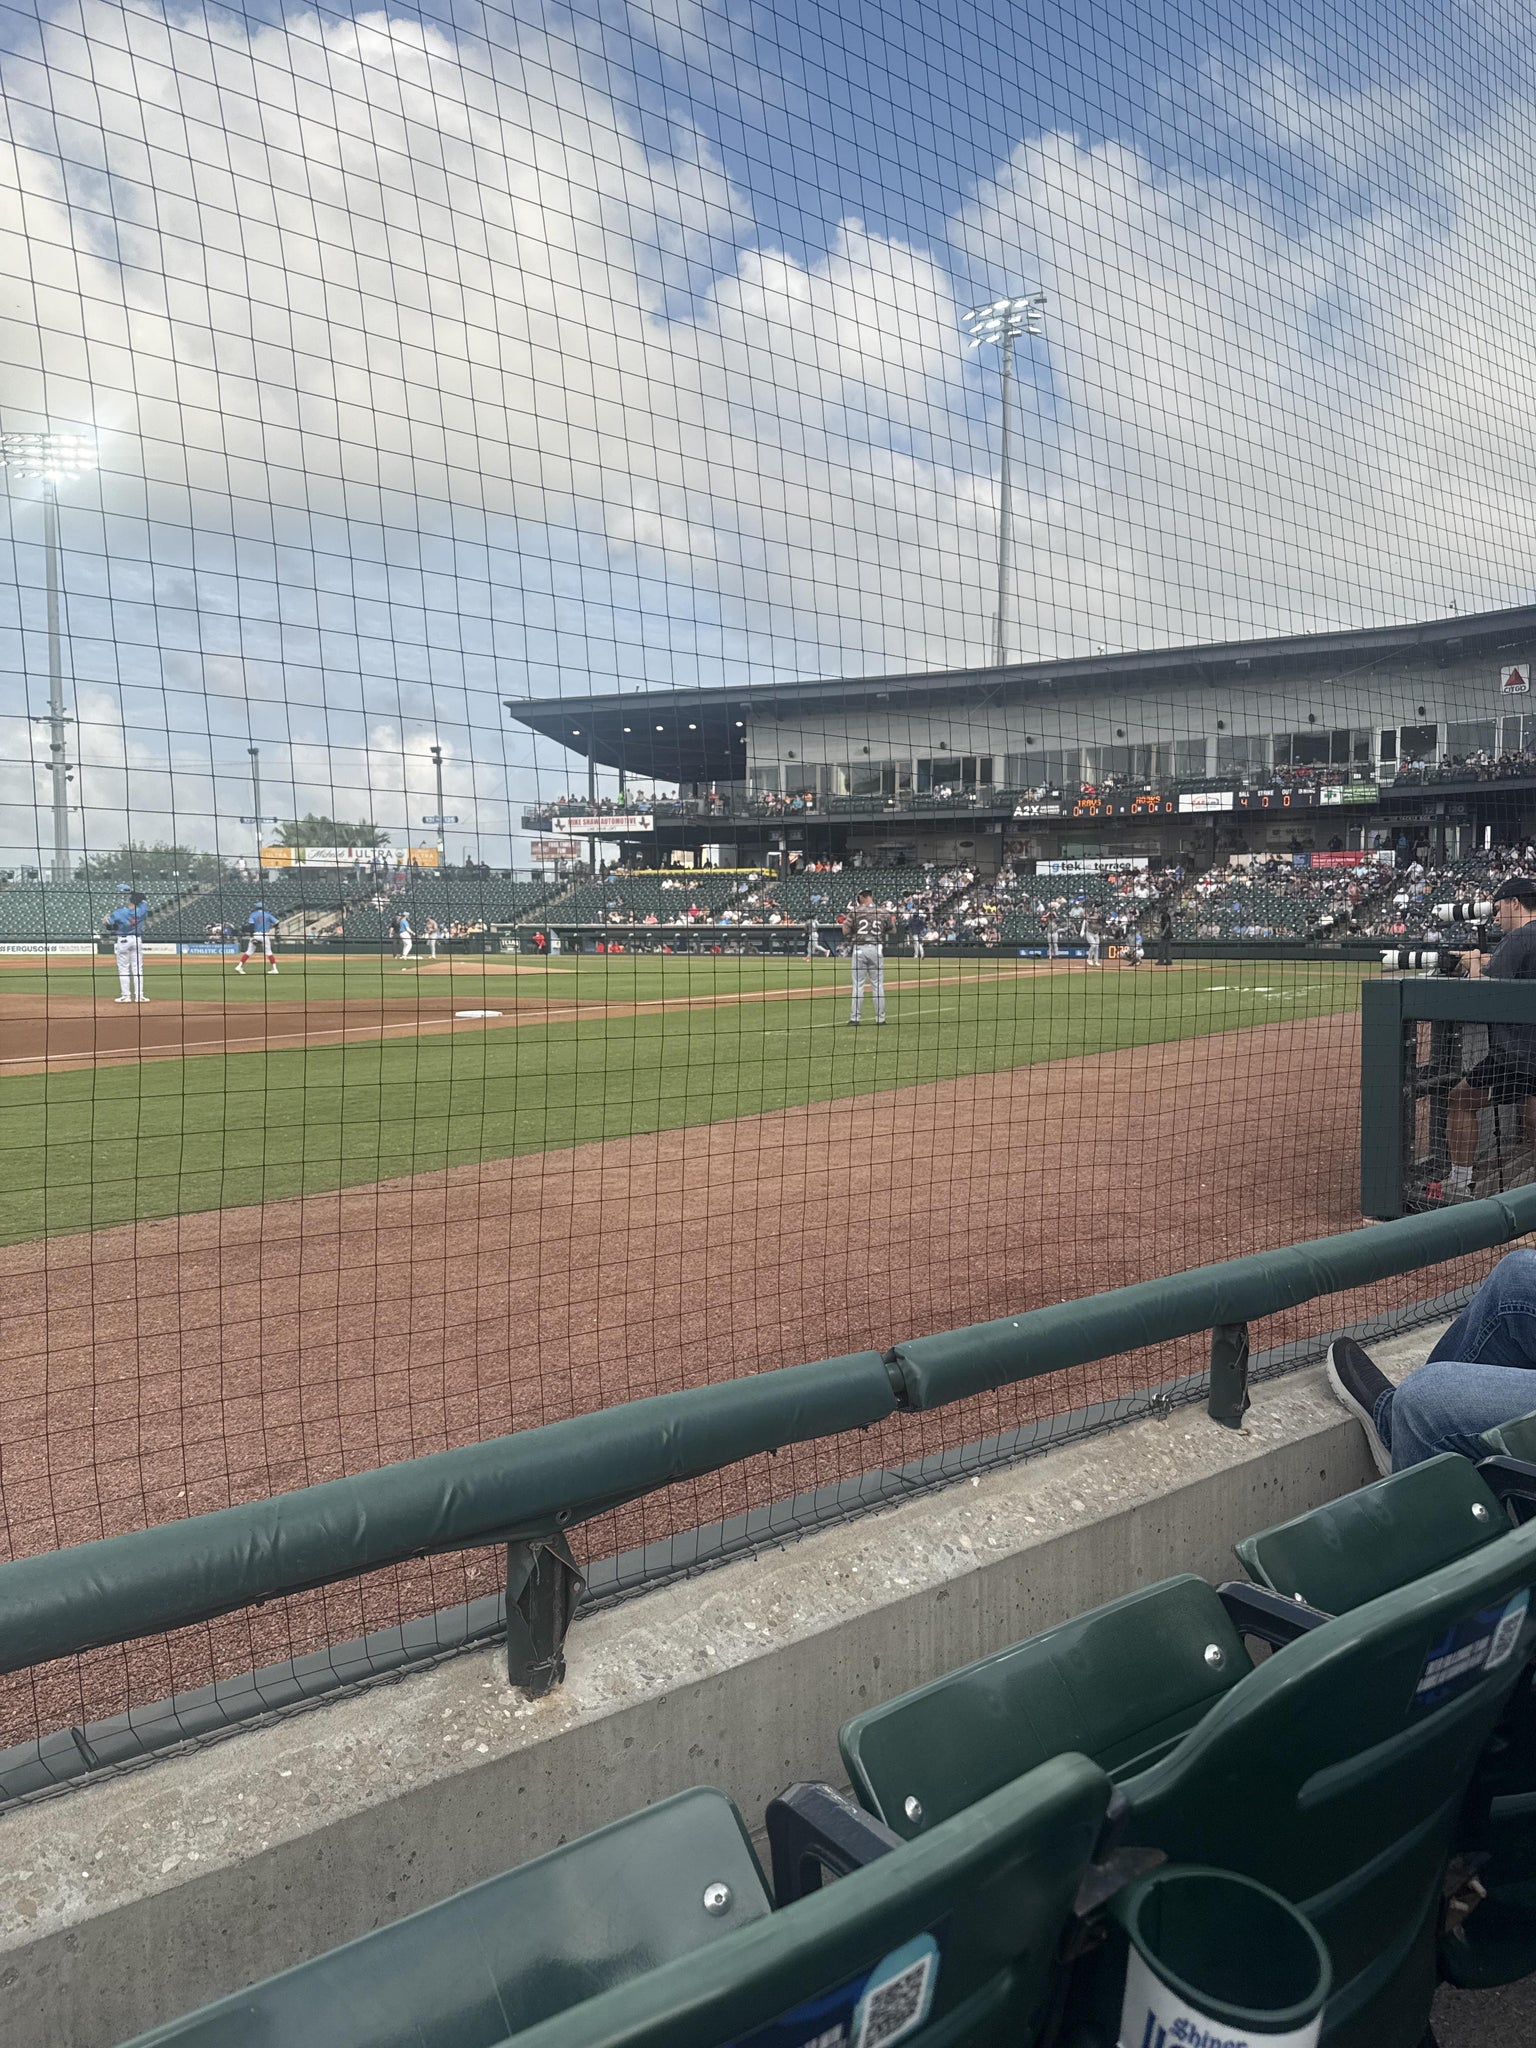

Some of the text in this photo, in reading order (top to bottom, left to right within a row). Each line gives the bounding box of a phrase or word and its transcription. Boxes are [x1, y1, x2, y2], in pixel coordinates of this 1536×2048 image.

[1504, 685, 1526, 693] CITGO
[1262, 796, 1269, 807] 0
[1283, 795, 1290, 806] 0
[1013, 805, 1040, 817] A2X
[1073, 806, 1079, 817] 0
[1090, 806, 1096, 816] 0
[1106, 804, 1112, 815] 0
[1131, 803, 1138, 814] 0
[1148, 802, 1155, 813] 0
[1165, 802, 1172, 812] 0
[600, 817, 636, 825] AUTOMOTIVE
[355, 849, 393, 858] ULTRA
[857, 919, 883, 935] 25
[1169, 2016, 1248, 2048] Shiner
